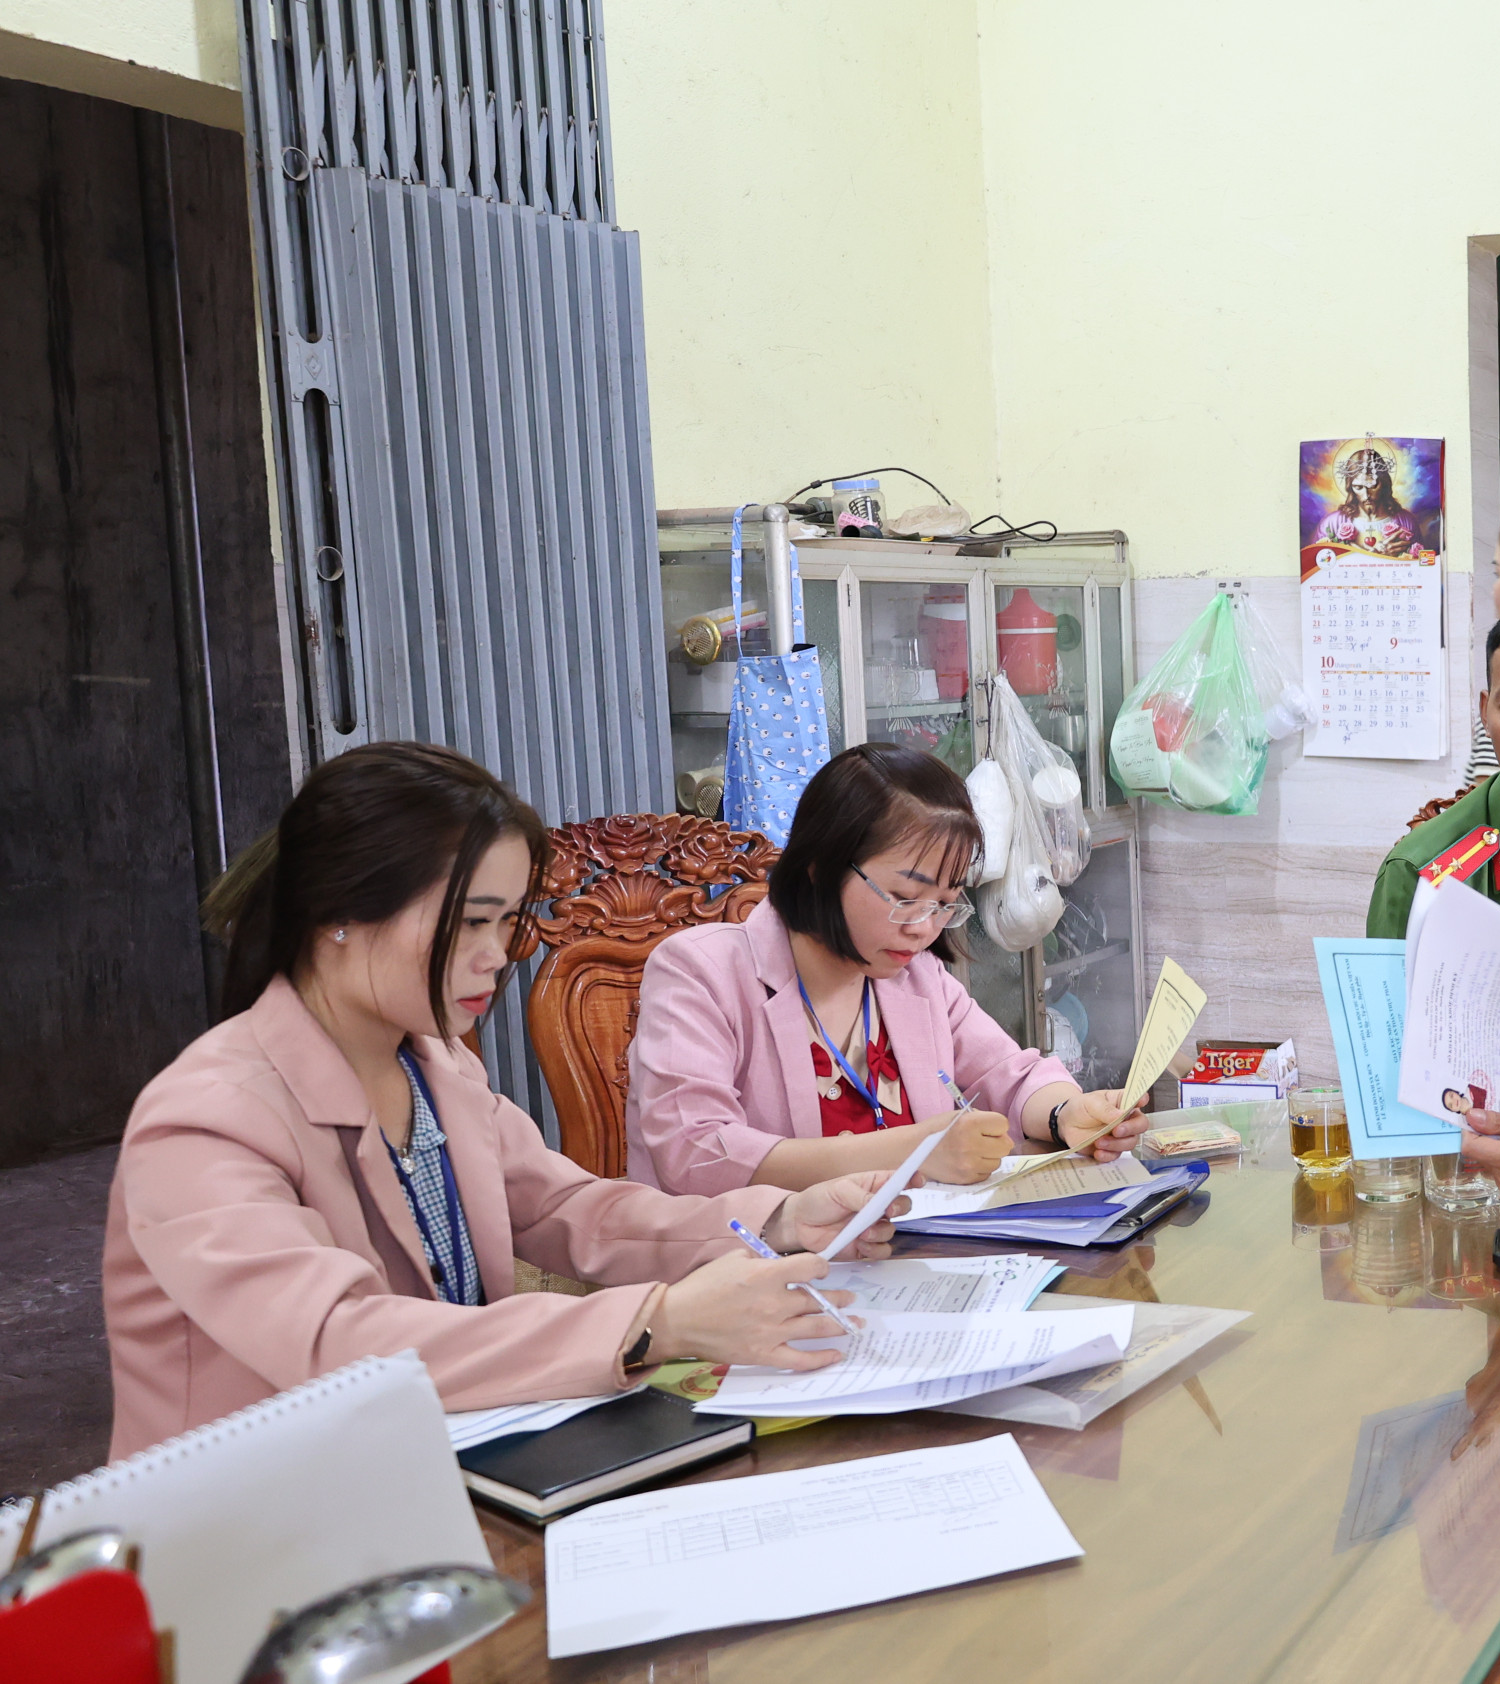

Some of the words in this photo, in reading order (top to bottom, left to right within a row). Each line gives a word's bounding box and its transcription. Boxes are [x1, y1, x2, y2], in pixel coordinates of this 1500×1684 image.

[1390, 637, 1398, 649] 9
[1321, 656, 1334, 668] 10
[1206, 1052, 1254, 1078] Tiger
